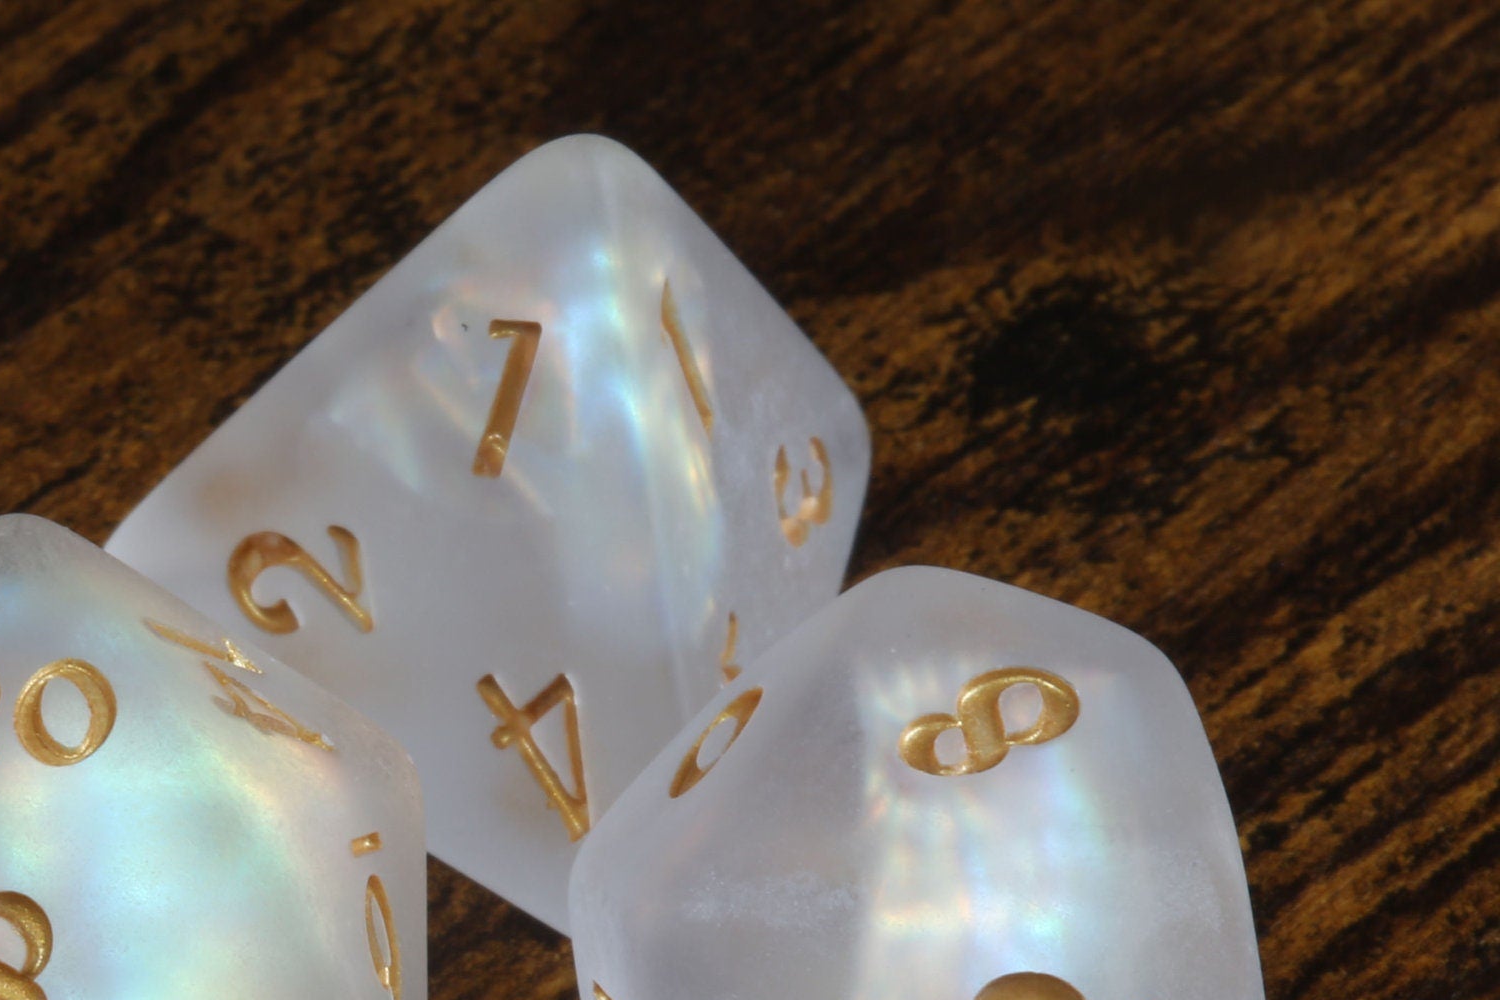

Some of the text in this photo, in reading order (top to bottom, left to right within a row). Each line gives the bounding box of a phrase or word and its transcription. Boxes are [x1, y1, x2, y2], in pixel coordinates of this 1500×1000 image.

[472, 318, 543, 478] 1
[227, 524, 374, 634] 2
[476, 672, 591, 843] 4
[898, 666, 1081, 777] 8
